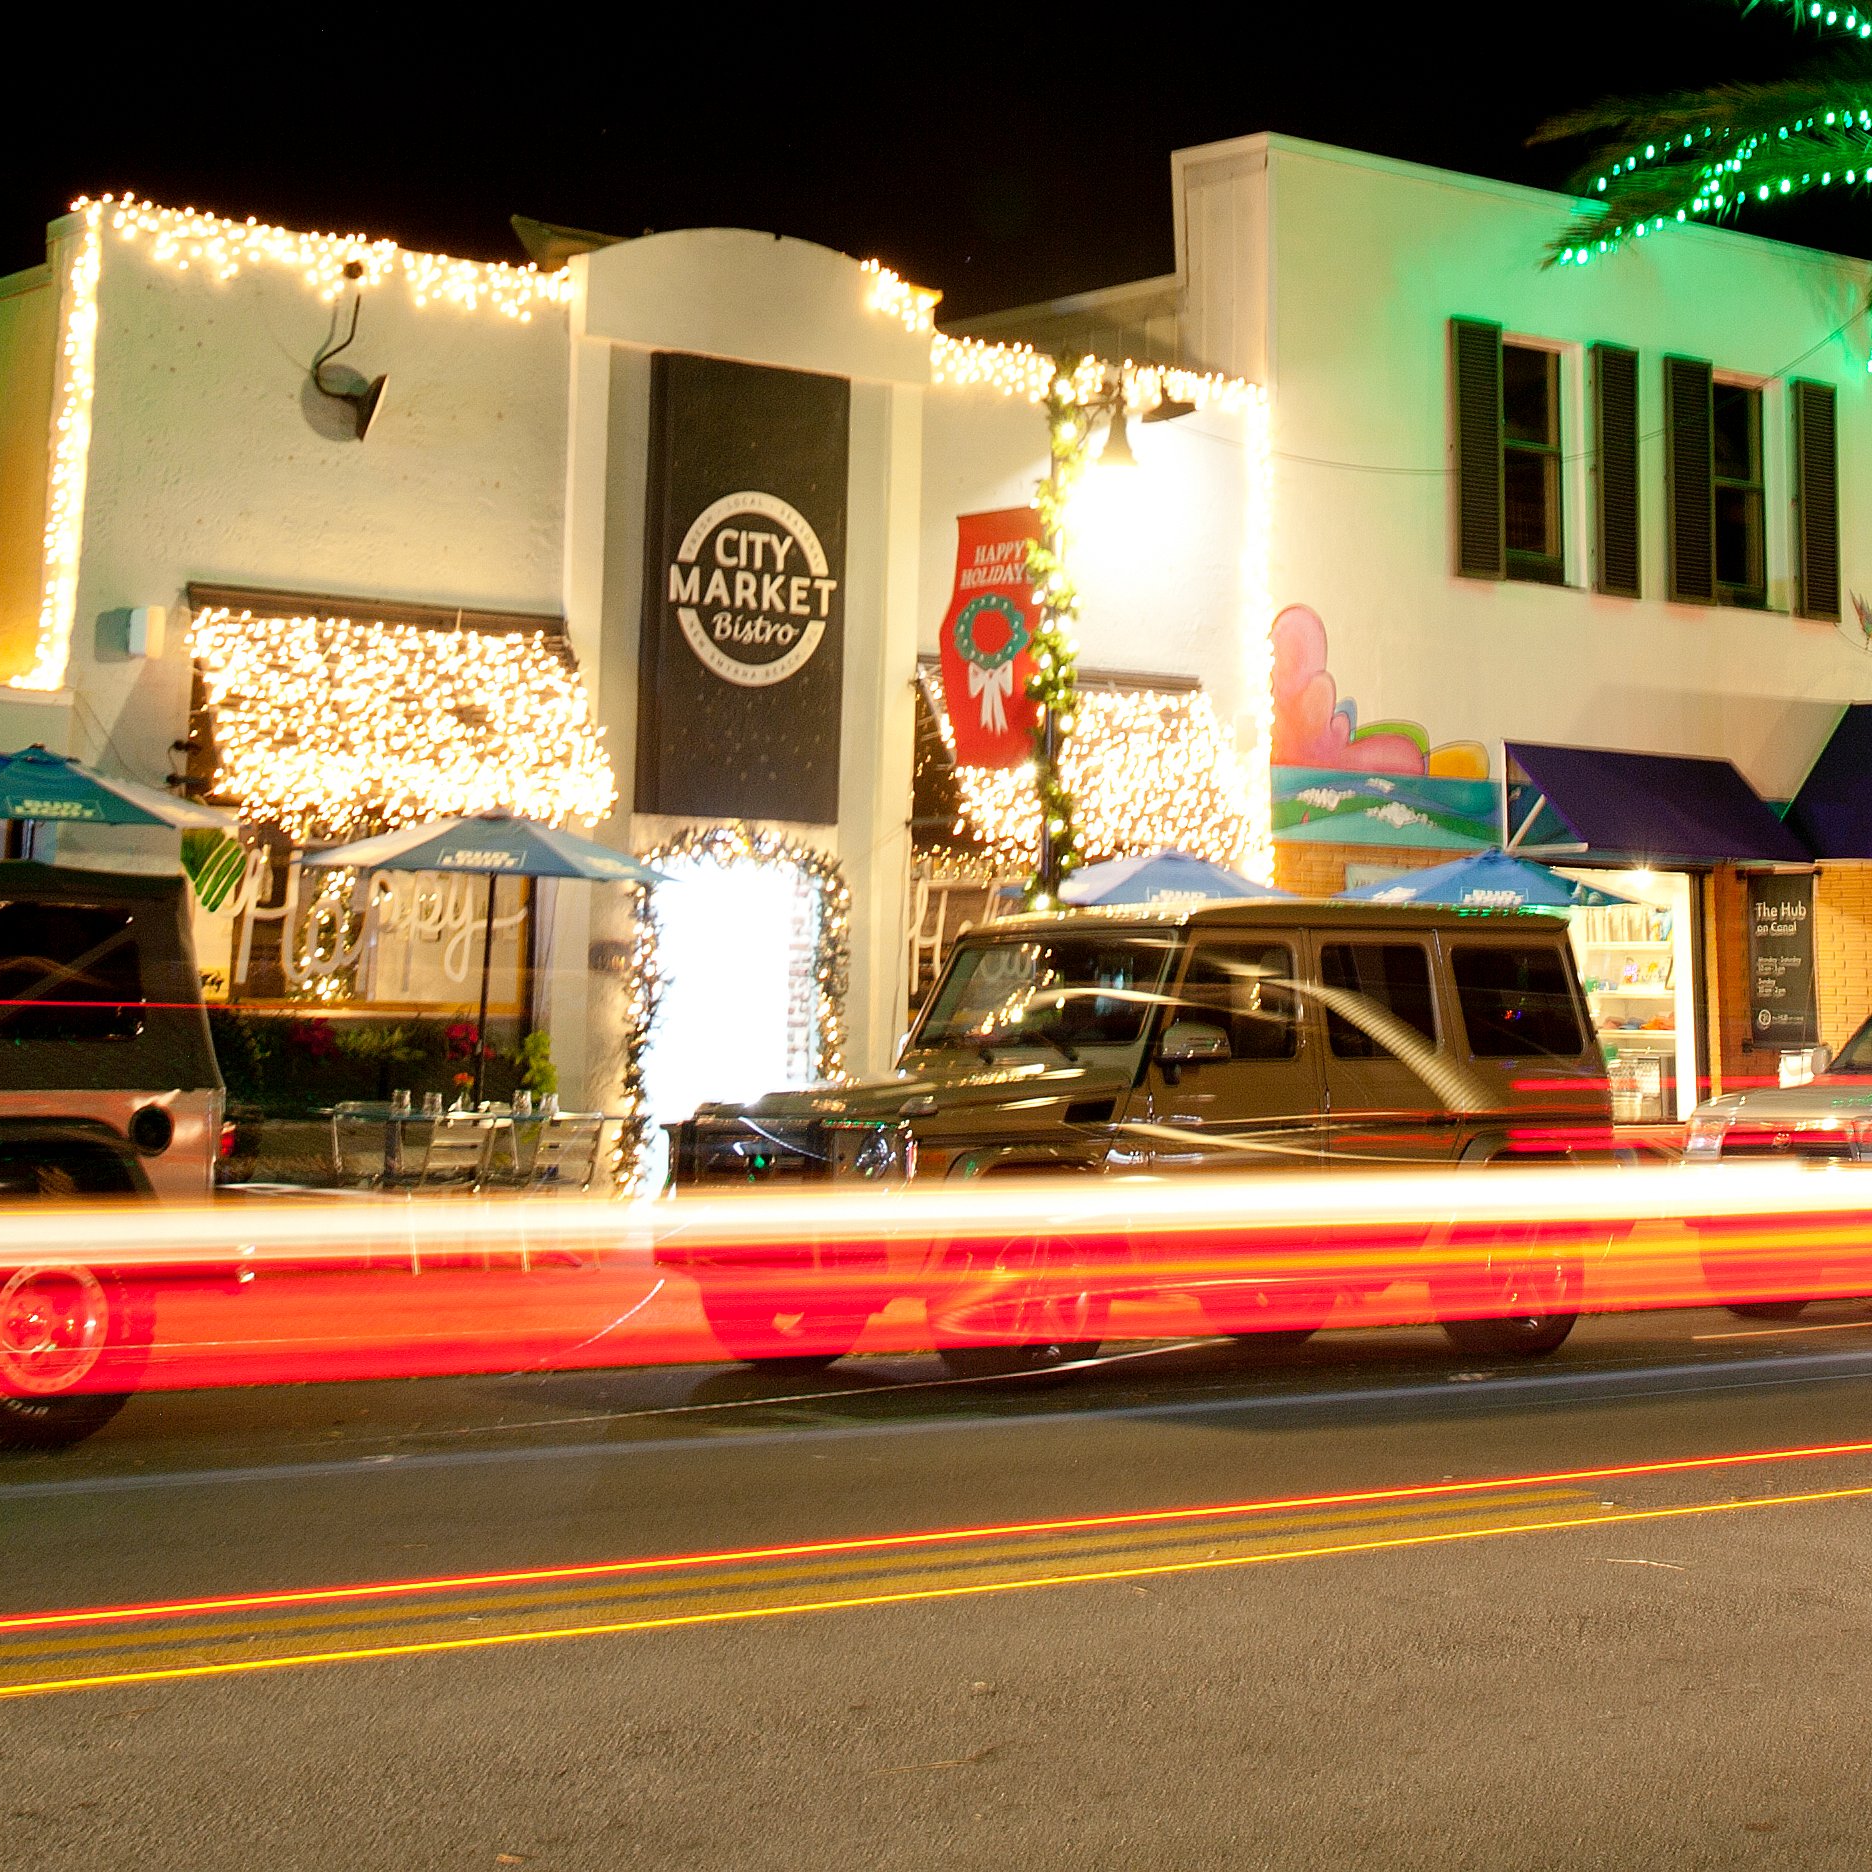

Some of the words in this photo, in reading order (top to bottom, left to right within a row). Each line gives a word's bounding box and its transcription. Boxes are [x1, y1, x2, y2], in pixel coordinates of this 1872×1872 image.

[714, 527, 794, 574] CITY
[973, 539, 1026, 566] HAPPY
[667, 562, 838, 619] MARKET
[711, 609, 800, 647] Bistro
[226, 846, 528, 1001] Happy
[1756, 901, 1778, 919] The
[1781, 900, 1807, 919] Hub
[1756, 924, 1769, 934] on
[1770, 921, 1797, 934] Canal
